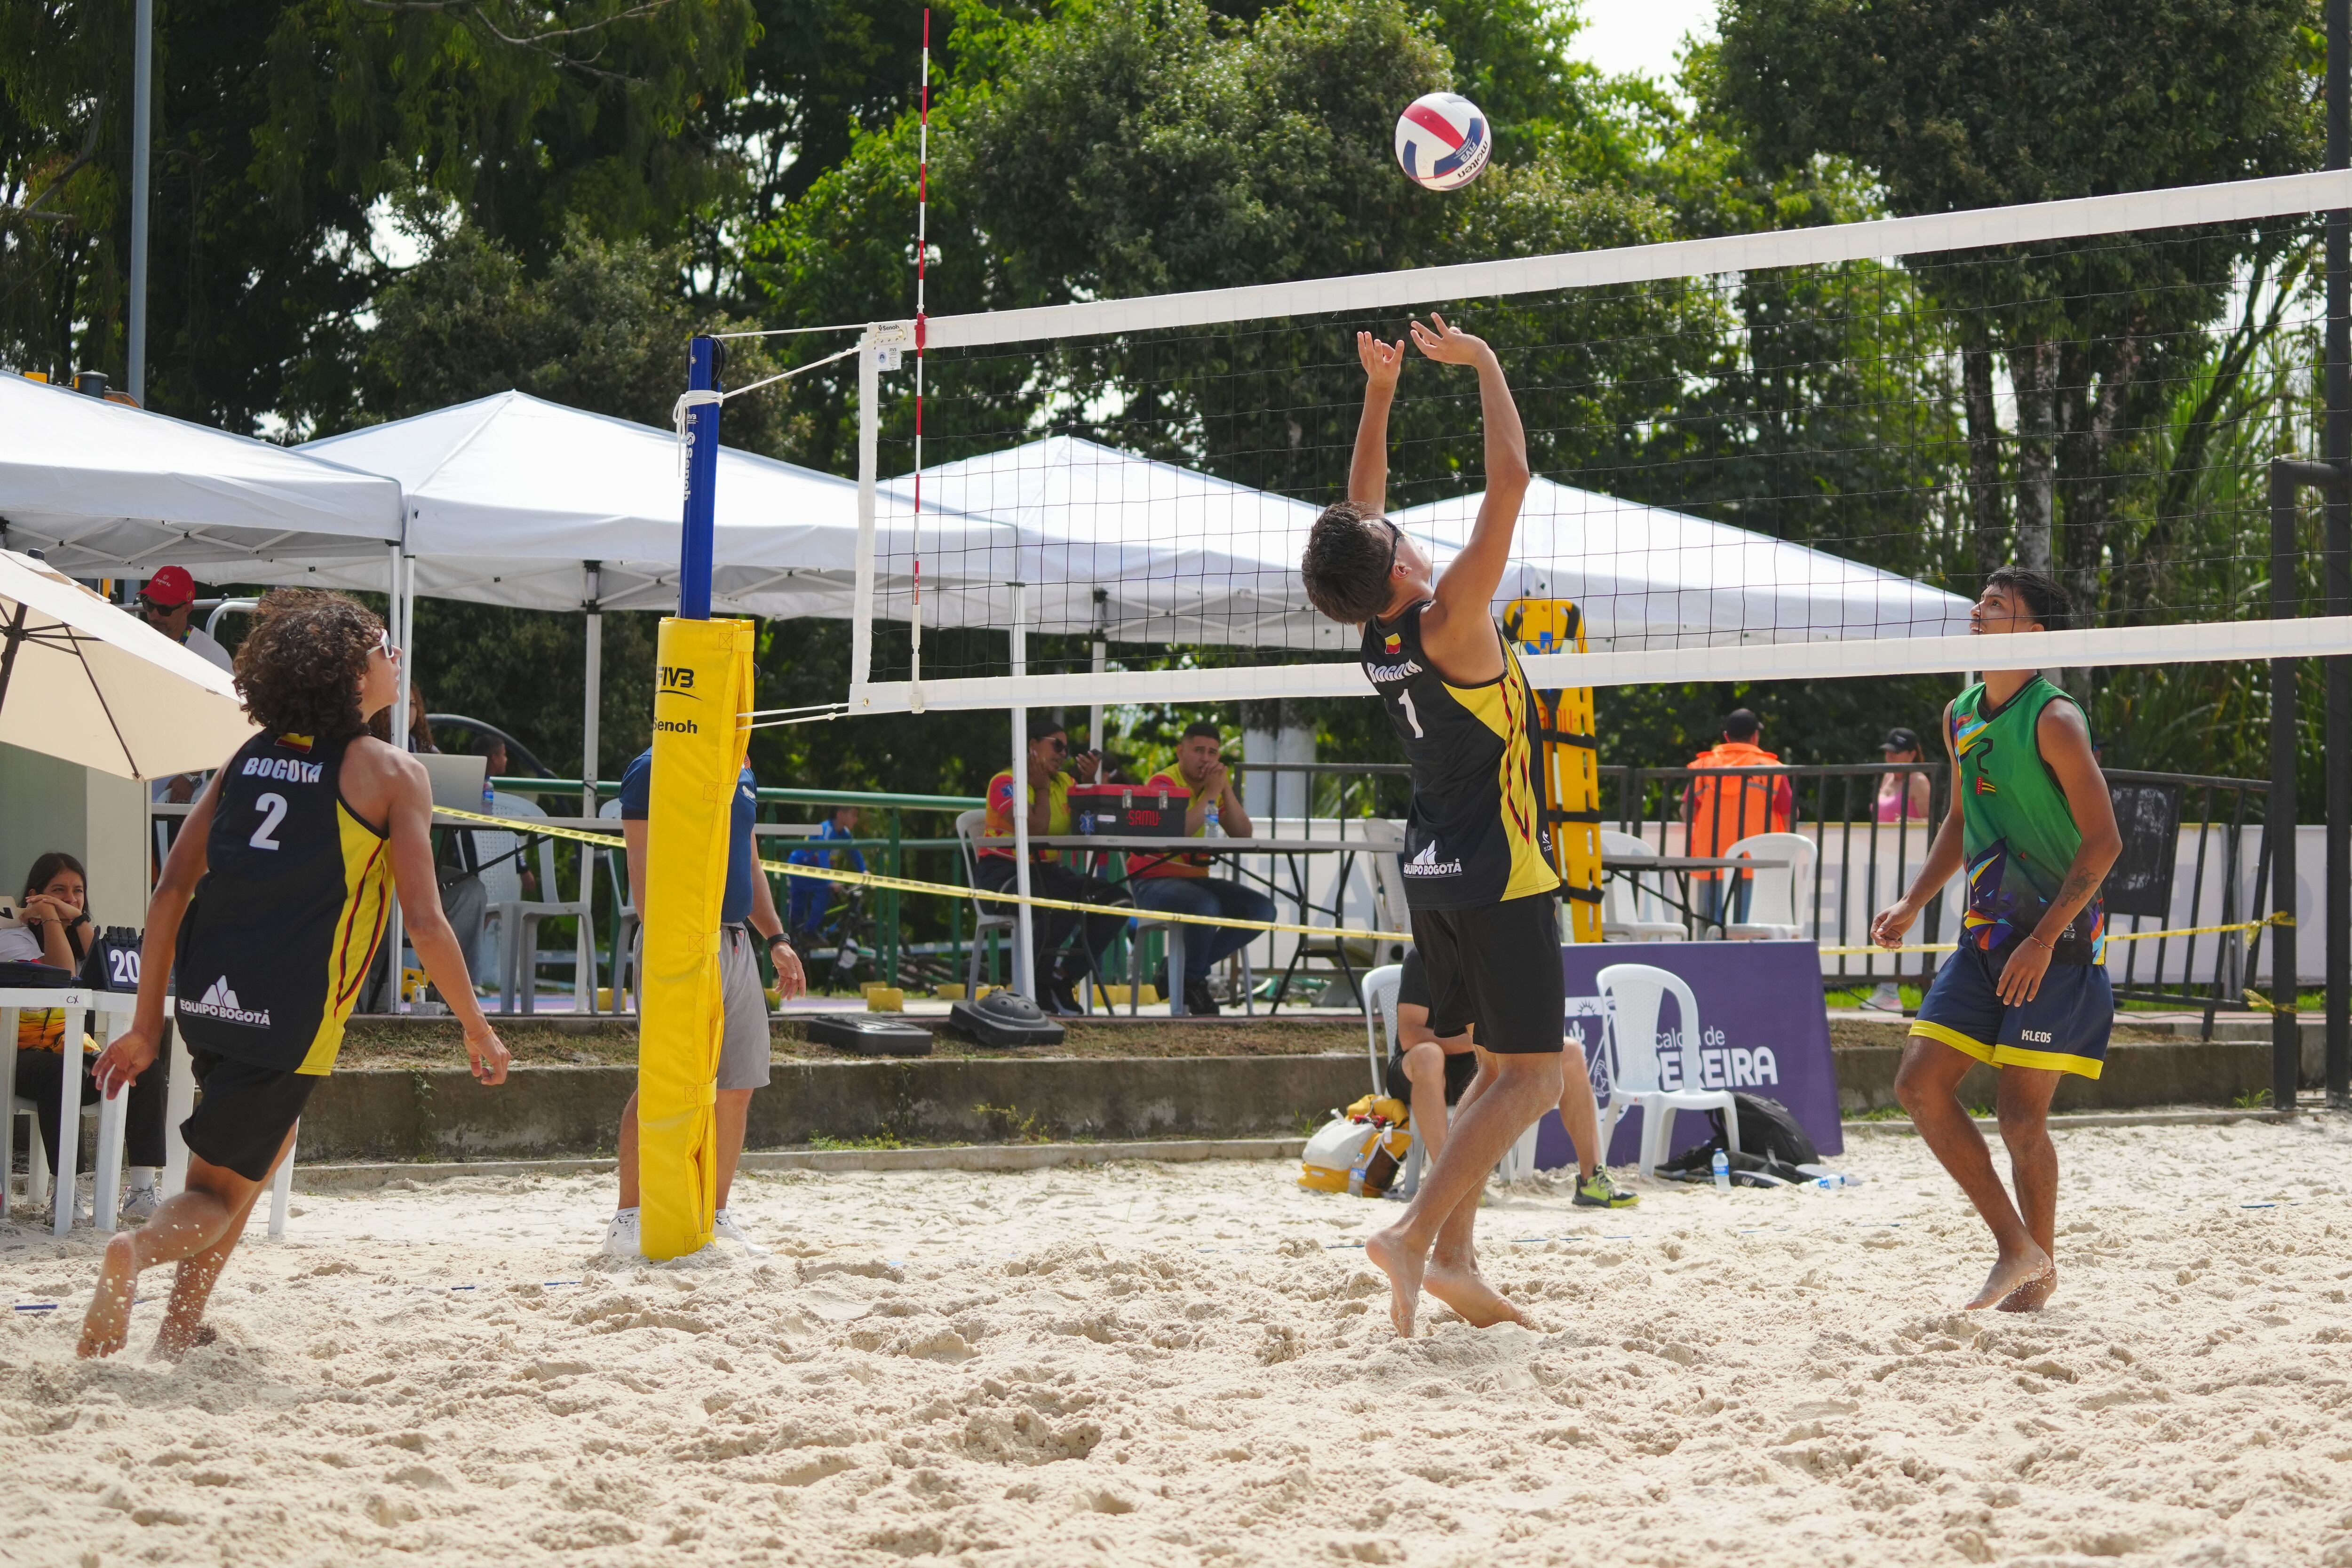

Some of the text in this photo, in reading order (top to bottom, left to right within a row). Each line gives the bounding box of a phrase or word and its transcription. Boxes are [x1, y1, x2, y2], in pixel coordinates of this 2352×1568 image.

[1457, 141, 1488, 177] molten
[684, 447, 693, 501] Senoh
[653, 716, 698, 733] Senoh
[1398, 689, 1424, 739] 1
[242, 757, 325, 783] BOGOTÁ
[249, 792, 288, 851] 2
[110, 949, 141, 983] 20
[180, 998, 219, 1016] EQUIPO
[1704, 1025, 1725, 1046] de
[2021, 1029, 2052, 1043] KLEOS
